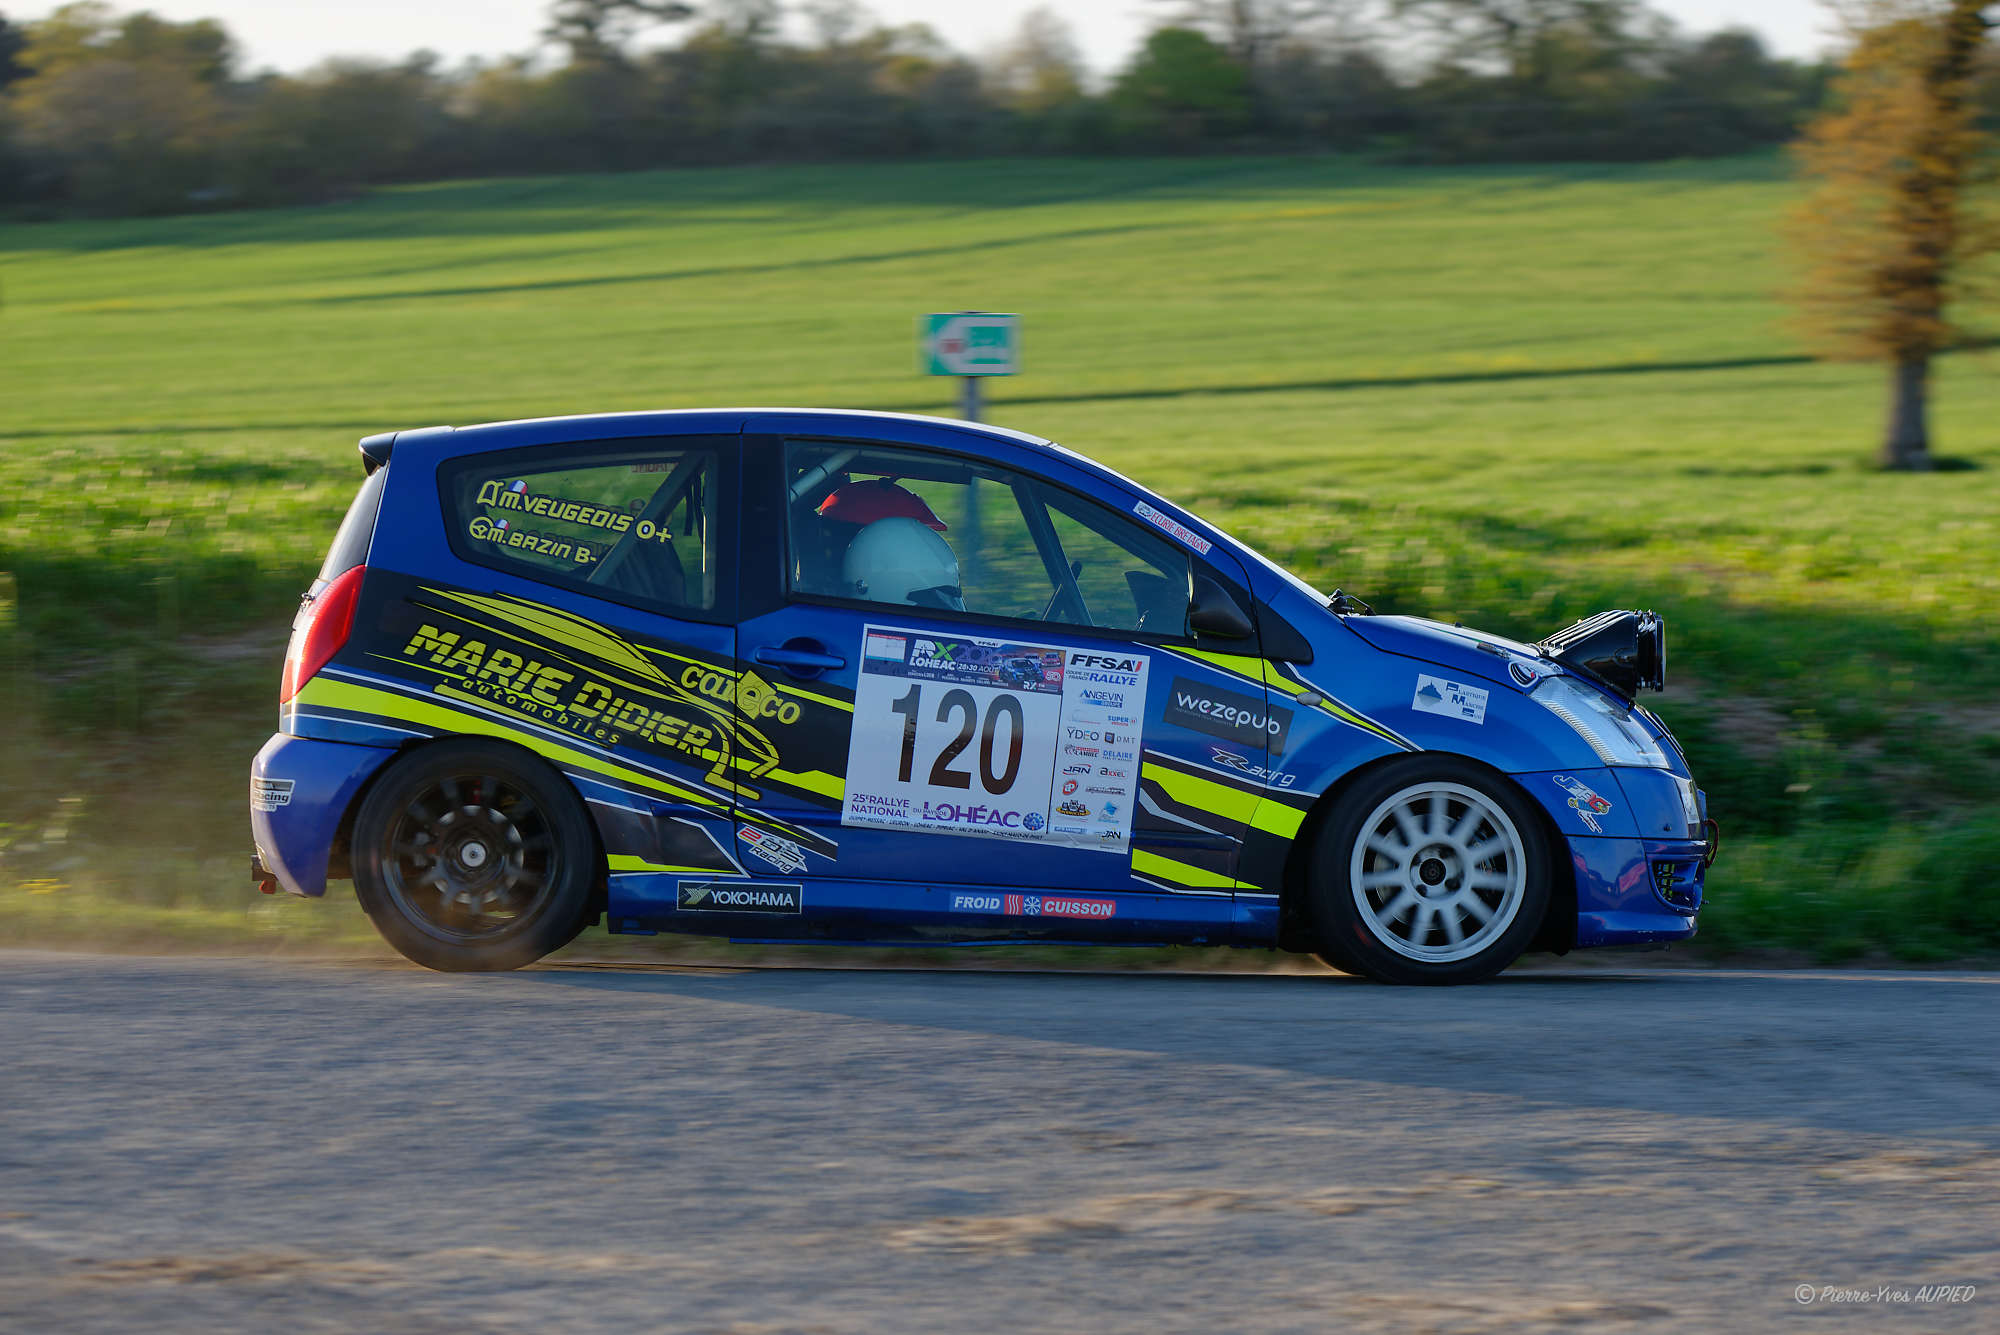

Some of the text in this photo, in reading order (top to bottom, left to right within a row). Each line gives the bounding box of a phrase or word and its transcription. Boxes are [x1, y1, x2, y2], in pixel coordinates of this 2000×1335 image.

[486, 527, 573, 559] M.BAZIN
[1151, 512, 1210, 553] ECURIE BRETAGNE
[912, 639, 958, 661] RX
[910, 655, 956, 670] LOHEAC
[1070, 654, 1133, 672] FFSA
[403, 624, 714, 755] MARIE DIDIER
[1090, 673, 1137, 687] RALLYE
[681, 665, 801, 725] careco
[1080, 689, 1124, 702] ANGEVIN
[462, 678, 620, 745] automobiles
[1177, 691, 1281, 735] wezepub
[892, 684, 1024, 795] 120
[851, 804, 908, 818] NATIONAL
[869, 796, 910, 808] RALLYE
[923, 801, 1021, 828] LOHÉAC
[751, 846, 793, 873] Racing
[711, 890, 794, 907] YOKOHAMA
[954, 896, 1113, 916] FROID CUISSON
